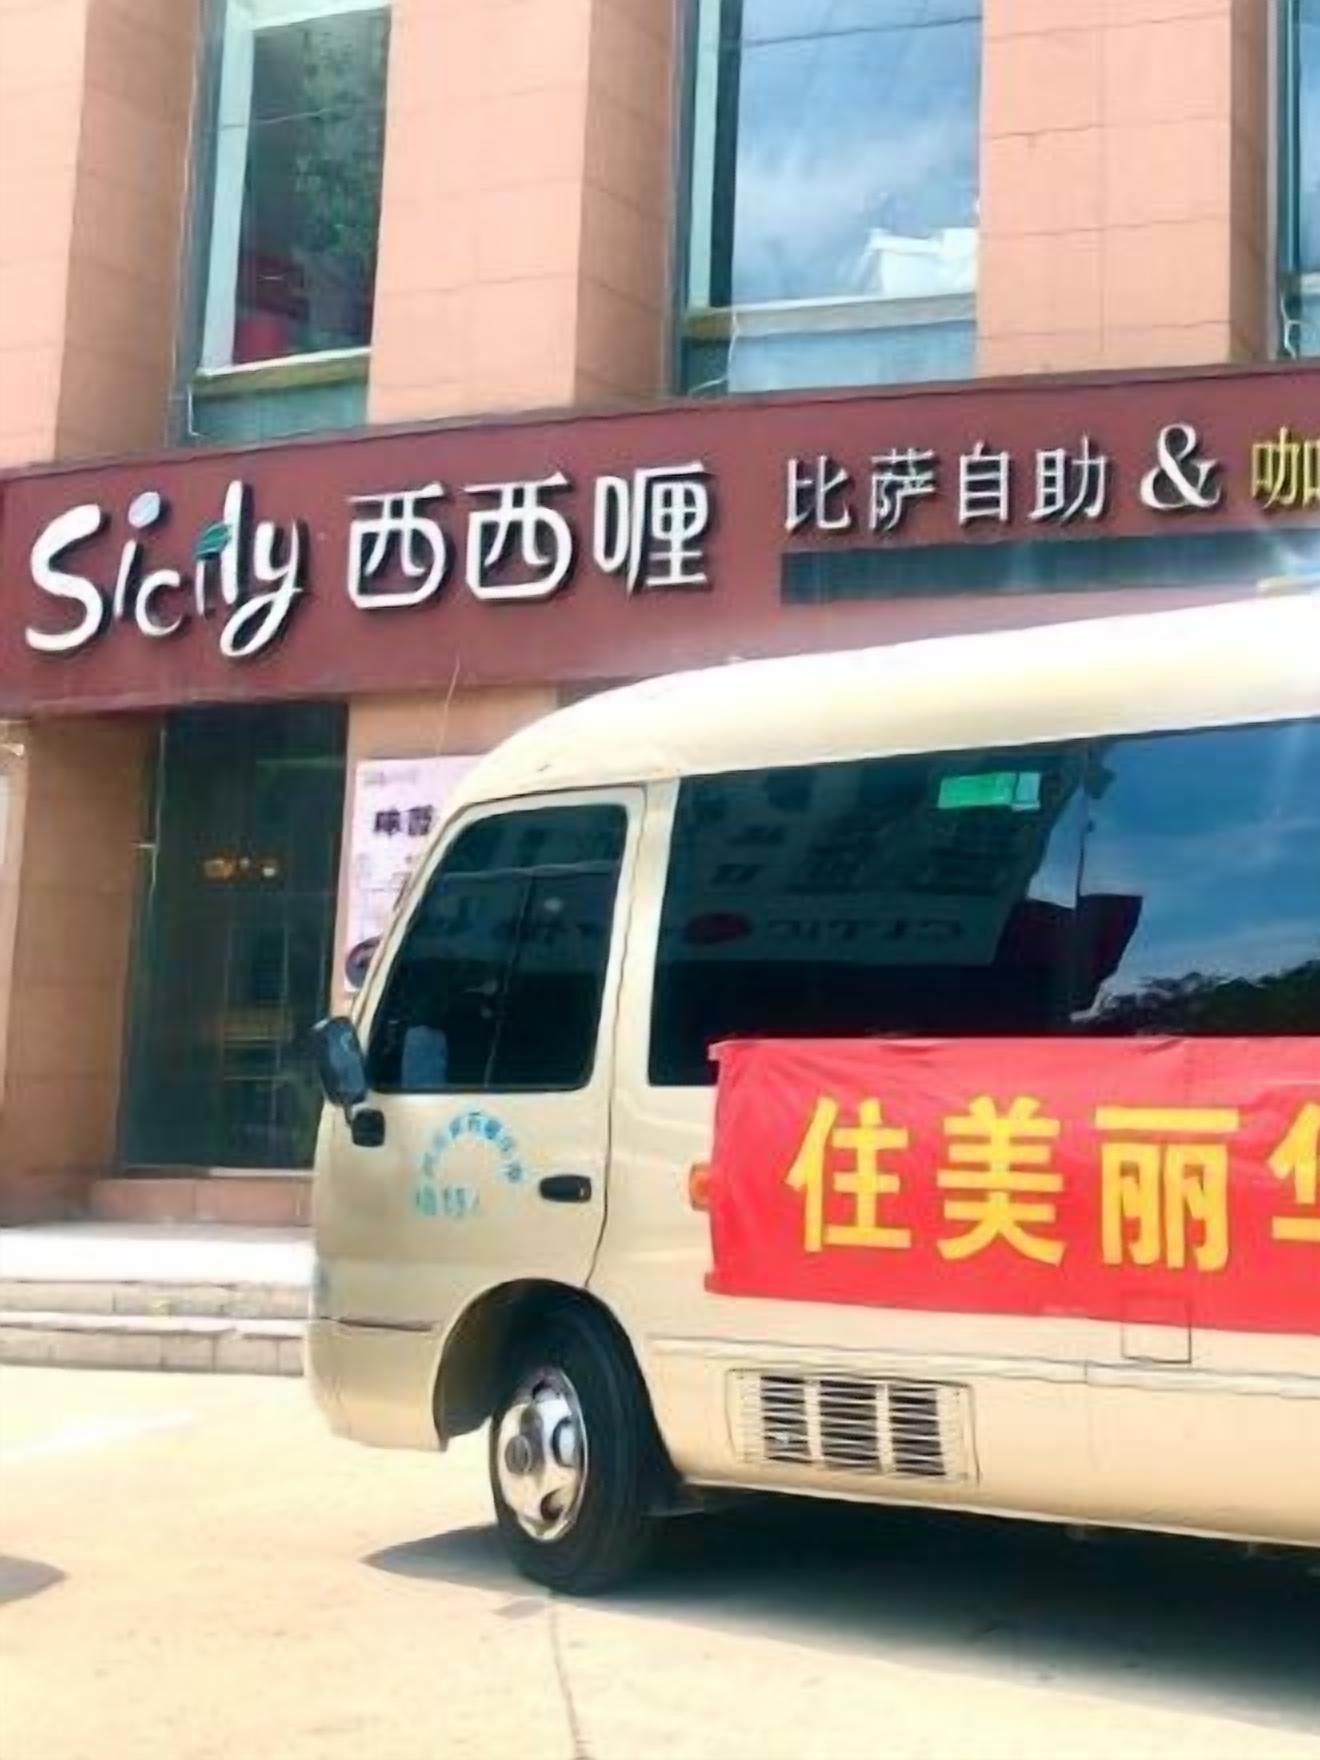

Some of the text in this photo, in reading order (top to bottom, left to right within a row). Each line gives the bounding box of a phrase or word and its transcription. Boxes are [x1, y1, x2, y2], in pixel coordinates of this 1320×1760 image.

[785, 436, 1108, 531] 比萨自助
[1140, 425, 1218, 510] &
[25, 461, 709, 658] Sicily 西西喱
